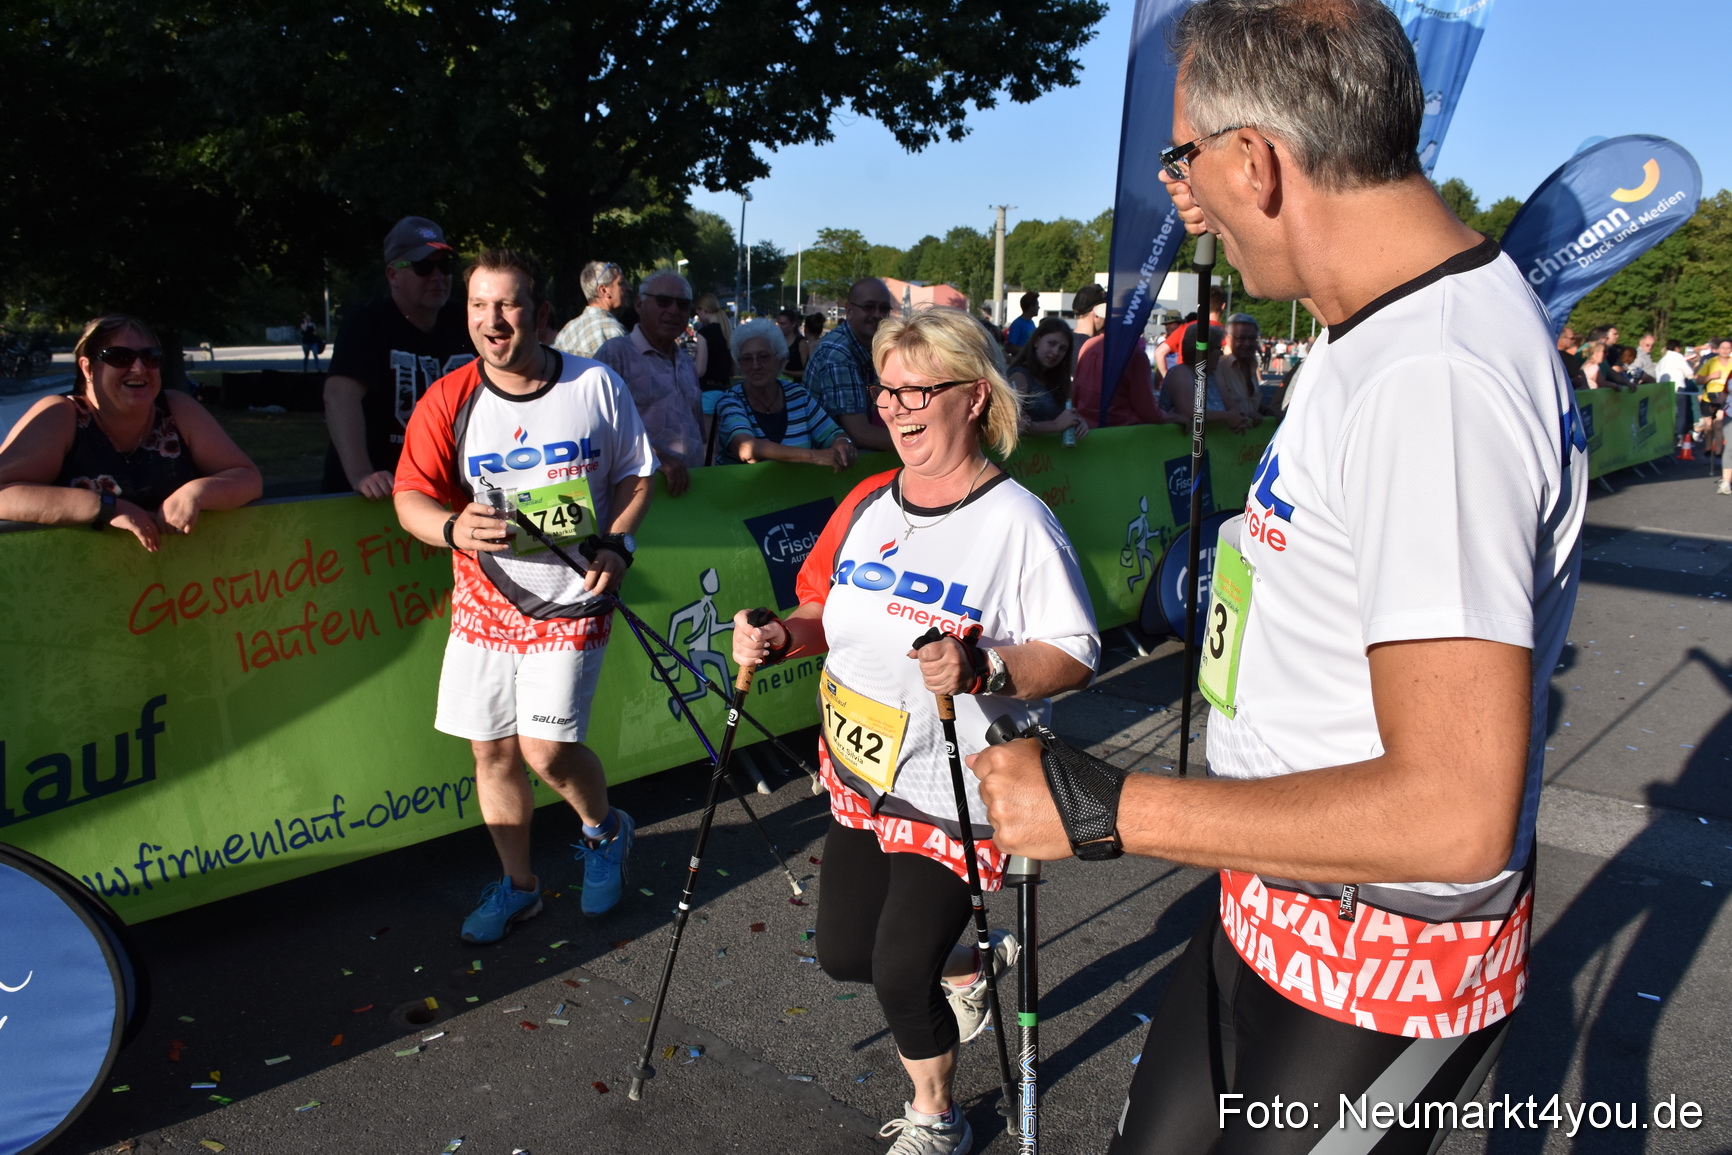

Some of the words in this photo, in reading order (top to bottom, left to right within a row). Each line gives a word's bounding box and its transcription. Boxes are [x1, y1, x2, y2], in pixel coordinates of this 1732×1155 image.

[1528, 207, 1631, 285] chmann
[1577, 240, 1614, 268] Druck
[1614, 222, 1640, 243] und
[1638, 189, 1686, 226] Medien
[1122, 206, 1177, 326] www.fischer-
[526, 503, 583, 535] 749
[778, 531, 820, 557] Fisch
[236, 601, 381, 673] laufen
[758, 655, 826, 695] neuma
[826, 703, 884, 765] 1742
